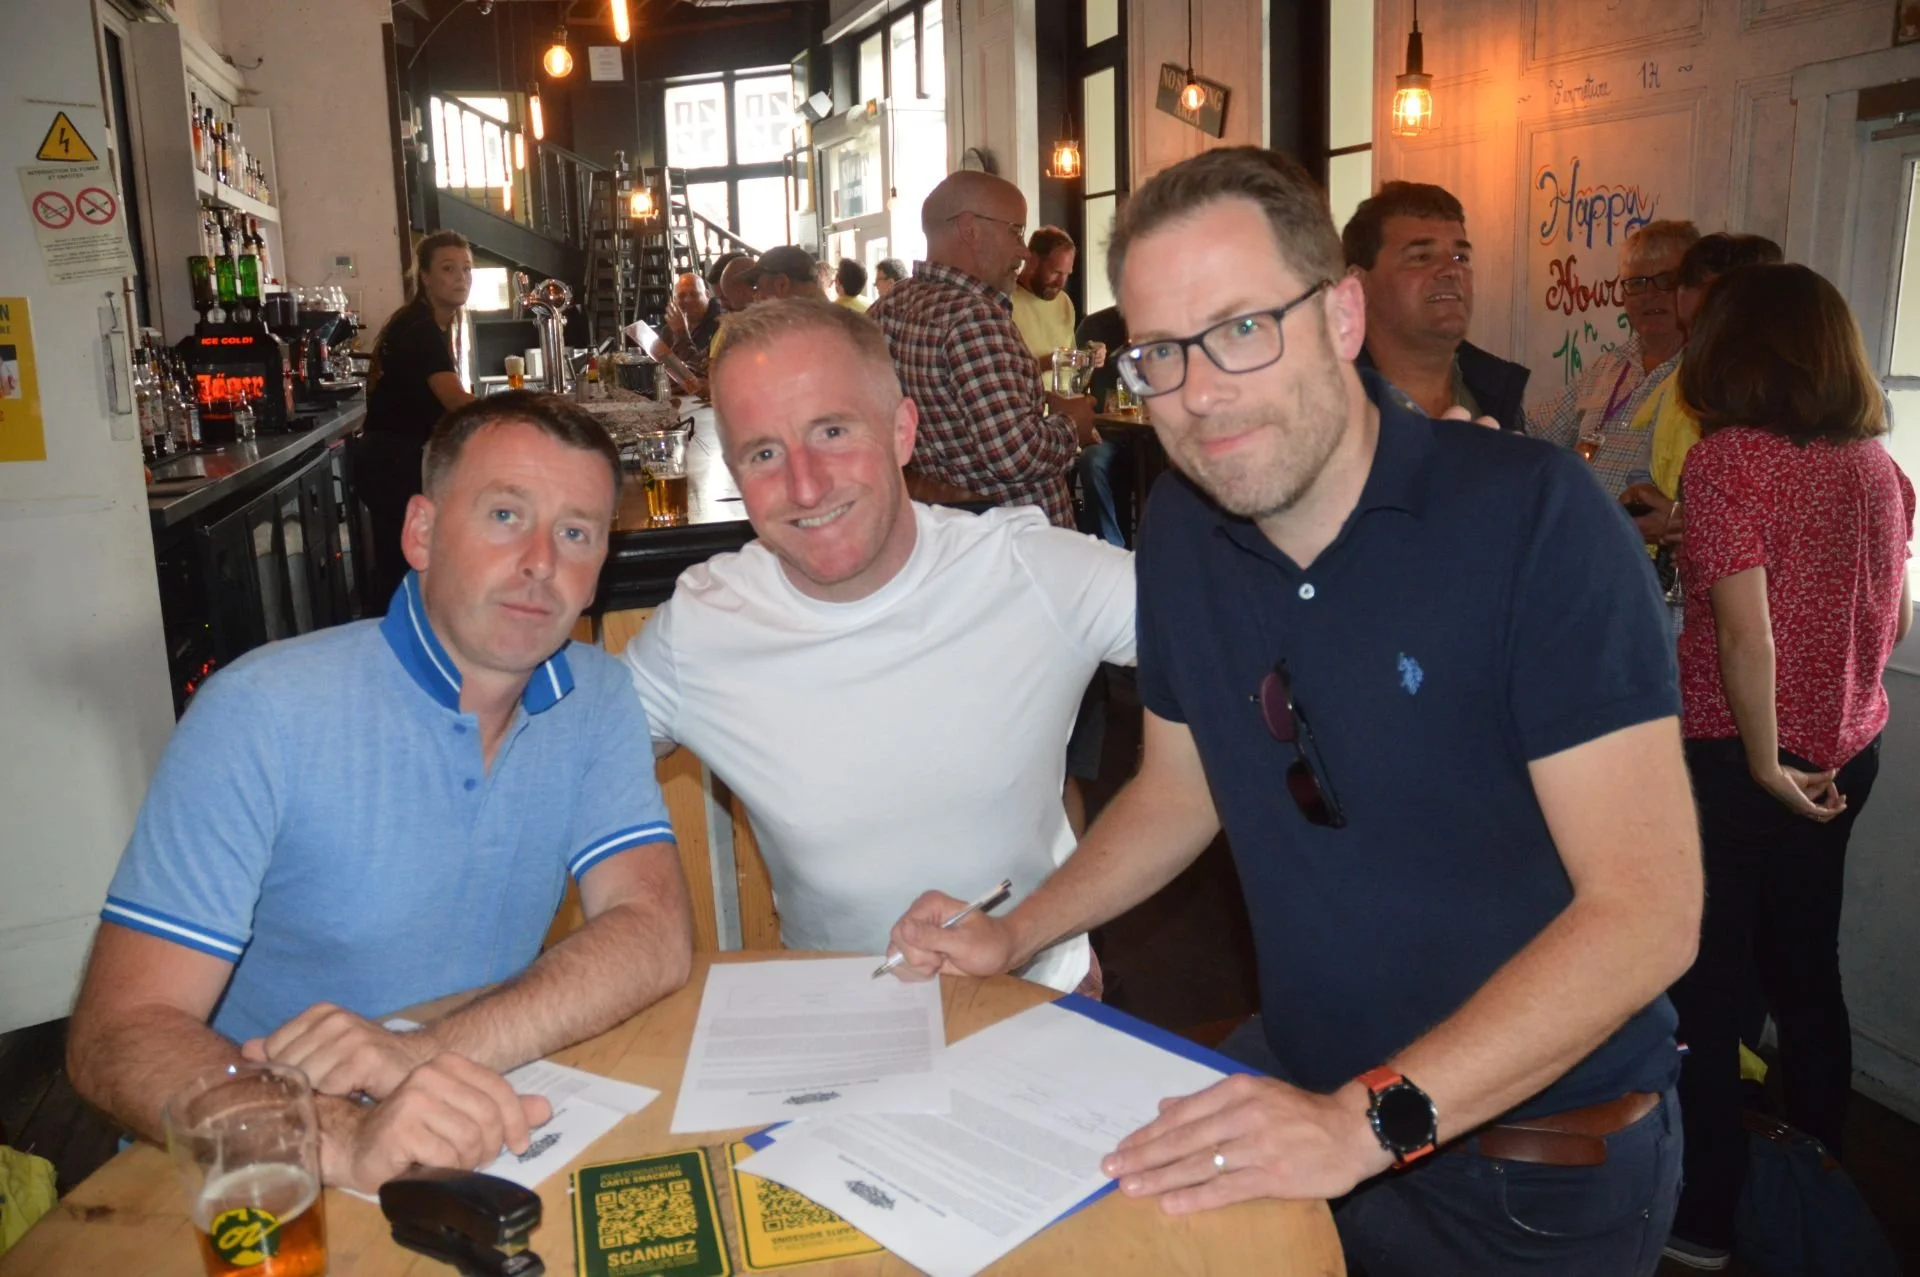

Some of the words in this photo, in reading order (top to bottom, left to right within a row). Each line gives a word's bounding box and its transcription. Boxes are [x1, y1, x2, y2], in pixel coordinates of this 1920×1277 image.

[1176, 73, 1225, 111] SING
[1538, 158, 1655, 249] Happy
[202, 337, 219, 345] ICE
[607, 1239, 698, 1268] SCANNEZ
